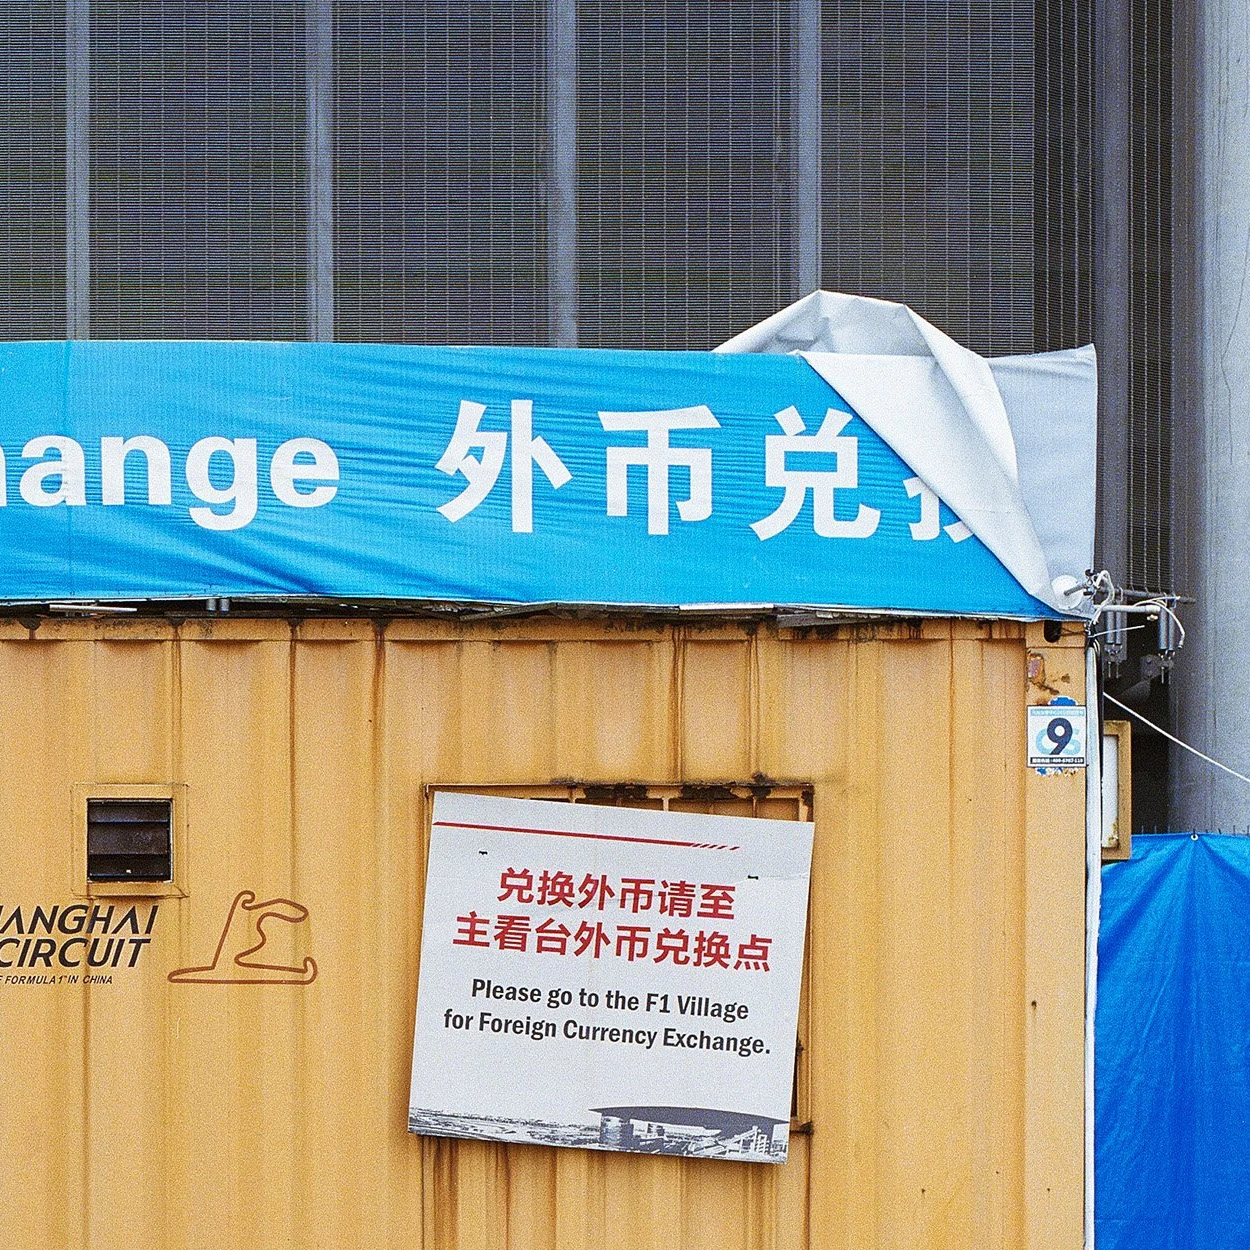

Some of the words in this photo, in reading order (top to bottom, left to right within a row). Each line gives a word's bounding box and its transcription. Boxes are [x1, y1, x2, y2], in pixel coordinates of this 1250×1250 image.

[435, 399, 973, 543] 外币兑
[1047, 717, 1073, 756] 9
[497, 867, 736, 920] 兑换外币请至
[453, 911, 773, 973] 主看台外币兑换点
[5, 975, 56, 985] FORMULA
[67, 975, 79, 985] IN
[83, 975, 113, 985] CHINA
[471, 978, 542, 1003] Please
[547, 986, 572, 1008] go
[579, 987, 599, 1008] to
[606, 988, 639, 1011] the
[645, 993, 670, 1014] F1
[677, 996, 749, 1025] Village
[444, 1008, 473, 1031] for
[478, 1012, 557, 1041] Foreign
[563, 1019, 658, 1049] Currency
[662, 1028, 771, 1057] Exchange.
